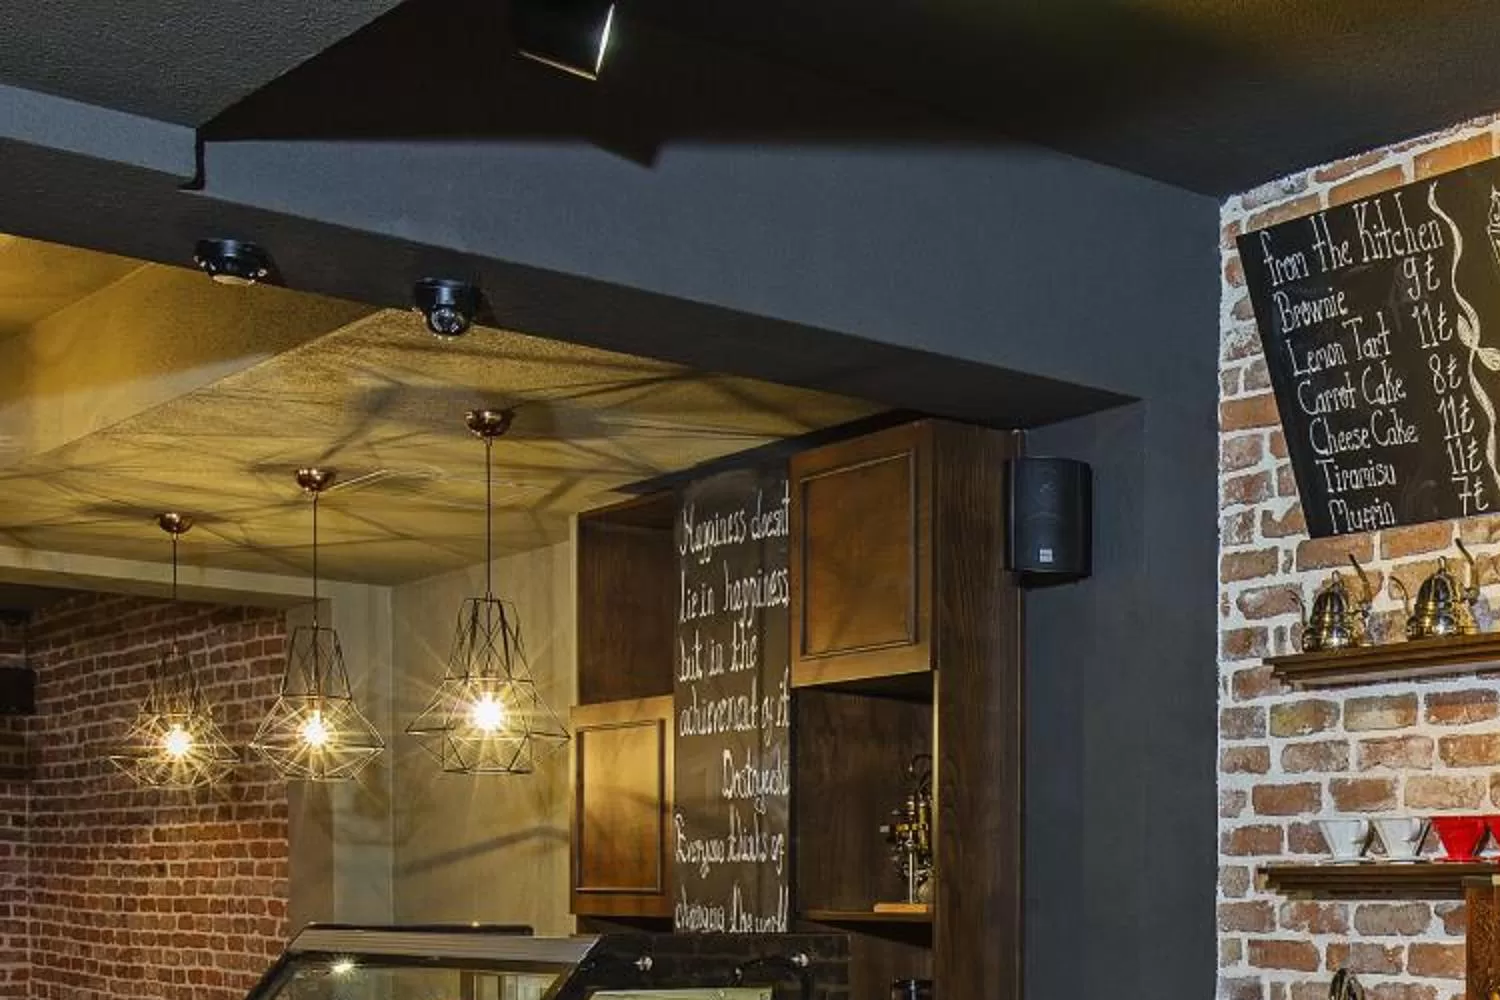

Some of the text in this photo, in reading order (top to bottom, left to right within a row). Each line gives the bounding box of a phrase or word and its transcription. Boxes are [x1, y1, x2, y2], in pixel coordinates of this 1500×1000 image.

[1352, 192, 1445, 263] Kitchen
[1273, 287, 1349, 334] Brownie
[1284, 339, 1348, 377] Lemon
[1342, 312, 1392, 363] Tart
[1297, 372, 1358, 417] Carrot
[1361, 360, 1408, 405] Cake
[1309, 417, 1371, 457] Cheese
[1371, 409, 1419, 447] Cake
[1315, 458, 1397, 493] Tiramisu
